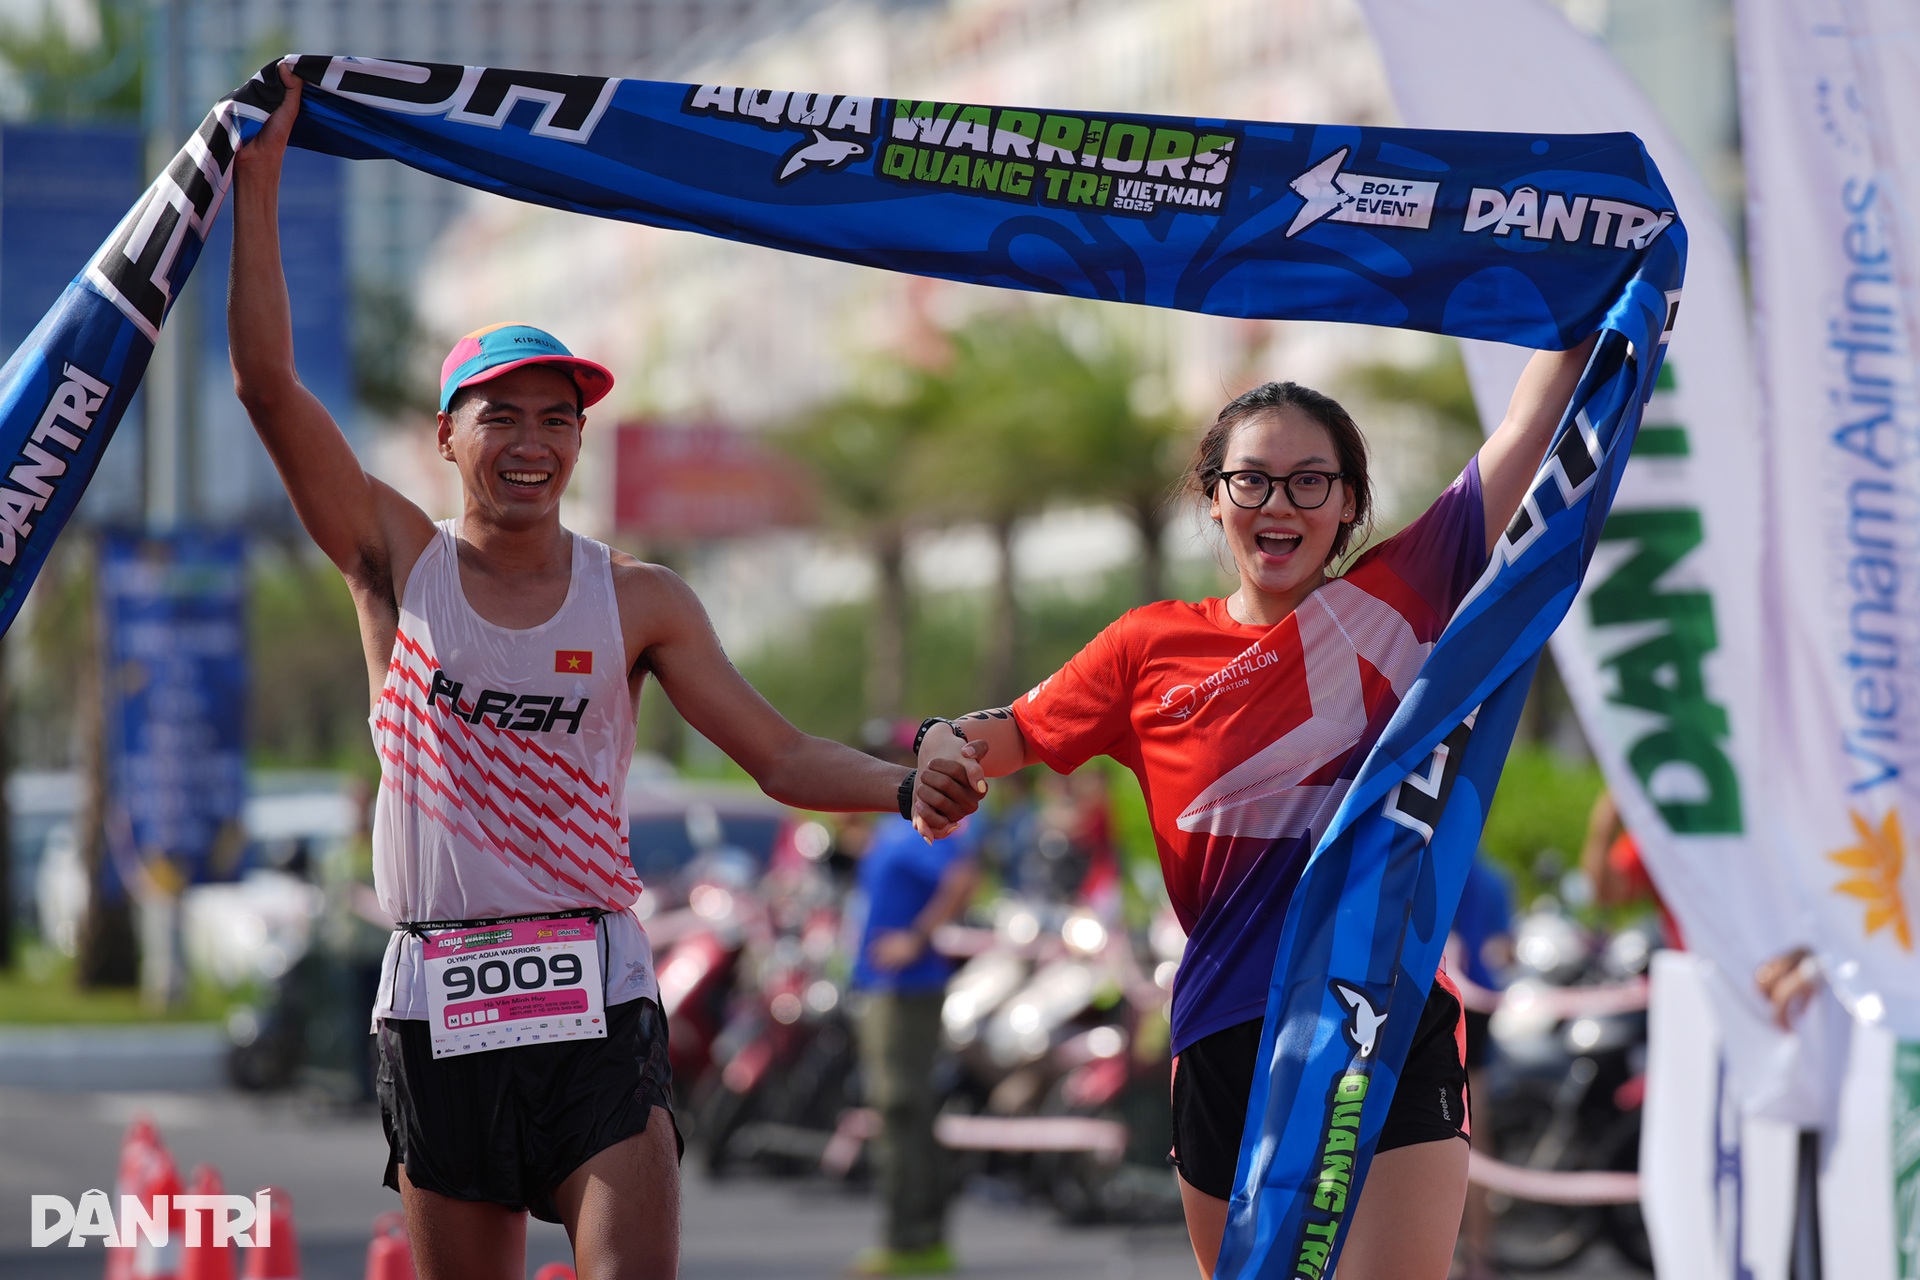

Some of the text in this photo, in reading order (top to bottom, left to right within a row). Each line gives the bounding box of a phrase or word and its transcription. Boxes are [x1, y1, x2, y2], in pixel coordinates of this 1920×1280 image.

[691, 83, 1235, 185] AQUA WARRIORS
[881, 144, 1034, 196] QUANG
[1113, 196, 1155, 213] 2025
[1117, 177, 1223, 209] VIETNAM
[1361, 181, 1413, 198] BOLT
[1356, 198, 1418, 218] EVENT
[1828, 177, 1897, 471] Airlines
[514, 337, 557, 351] KIPRUN
[1838, 480, 1904, 796] Vietnam
[1200, 650, 1279, 692] TRIATHLON
[438, 936, 463, 948] AQUA
[447, 952, 478, 965] OLYMPIC
[479, 950, 499, 961] AQUA
[500, 946, 541, 958] WARRIORS
[442, 953, 583, 1001] 9009
[1438, 1086, 1451, 1121] Reebok
